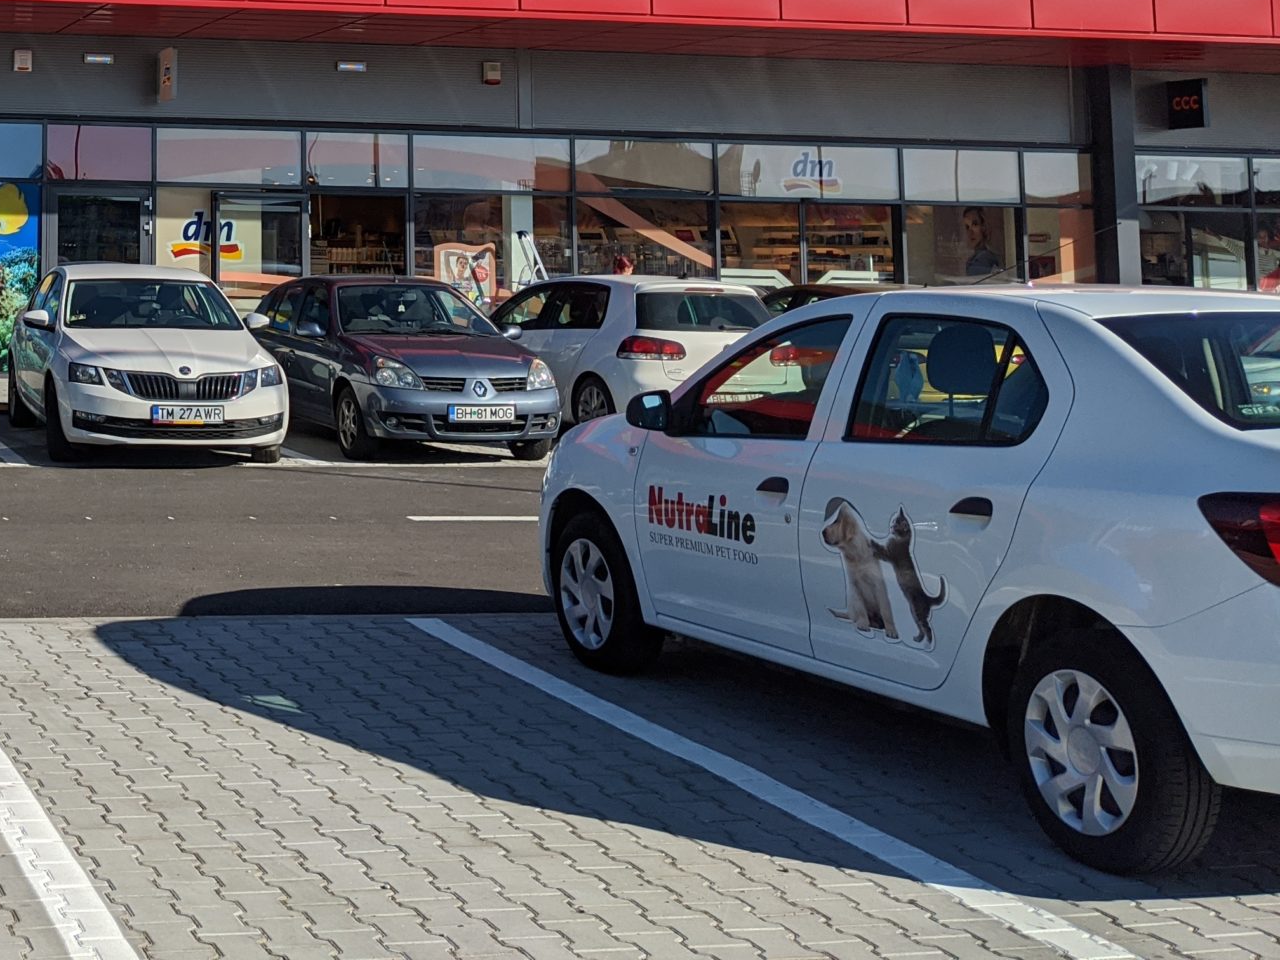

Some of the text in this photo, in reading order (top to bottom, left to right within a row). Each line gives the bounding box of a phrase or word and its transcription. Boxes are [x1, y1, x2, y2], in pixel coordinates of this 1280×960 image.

[1172, 95, 1199, 111] CCC
[792, 151, 834, 178] dm
[182, 211, 234, 242] dm
[159, 407, 175, 420] TM
[456, 407, 513, 419] BH 81 MOG
[648, 485, 756, 545] NutraLine
[649, 531, 759, 566] SUPER PREMIUM PET FOOD
